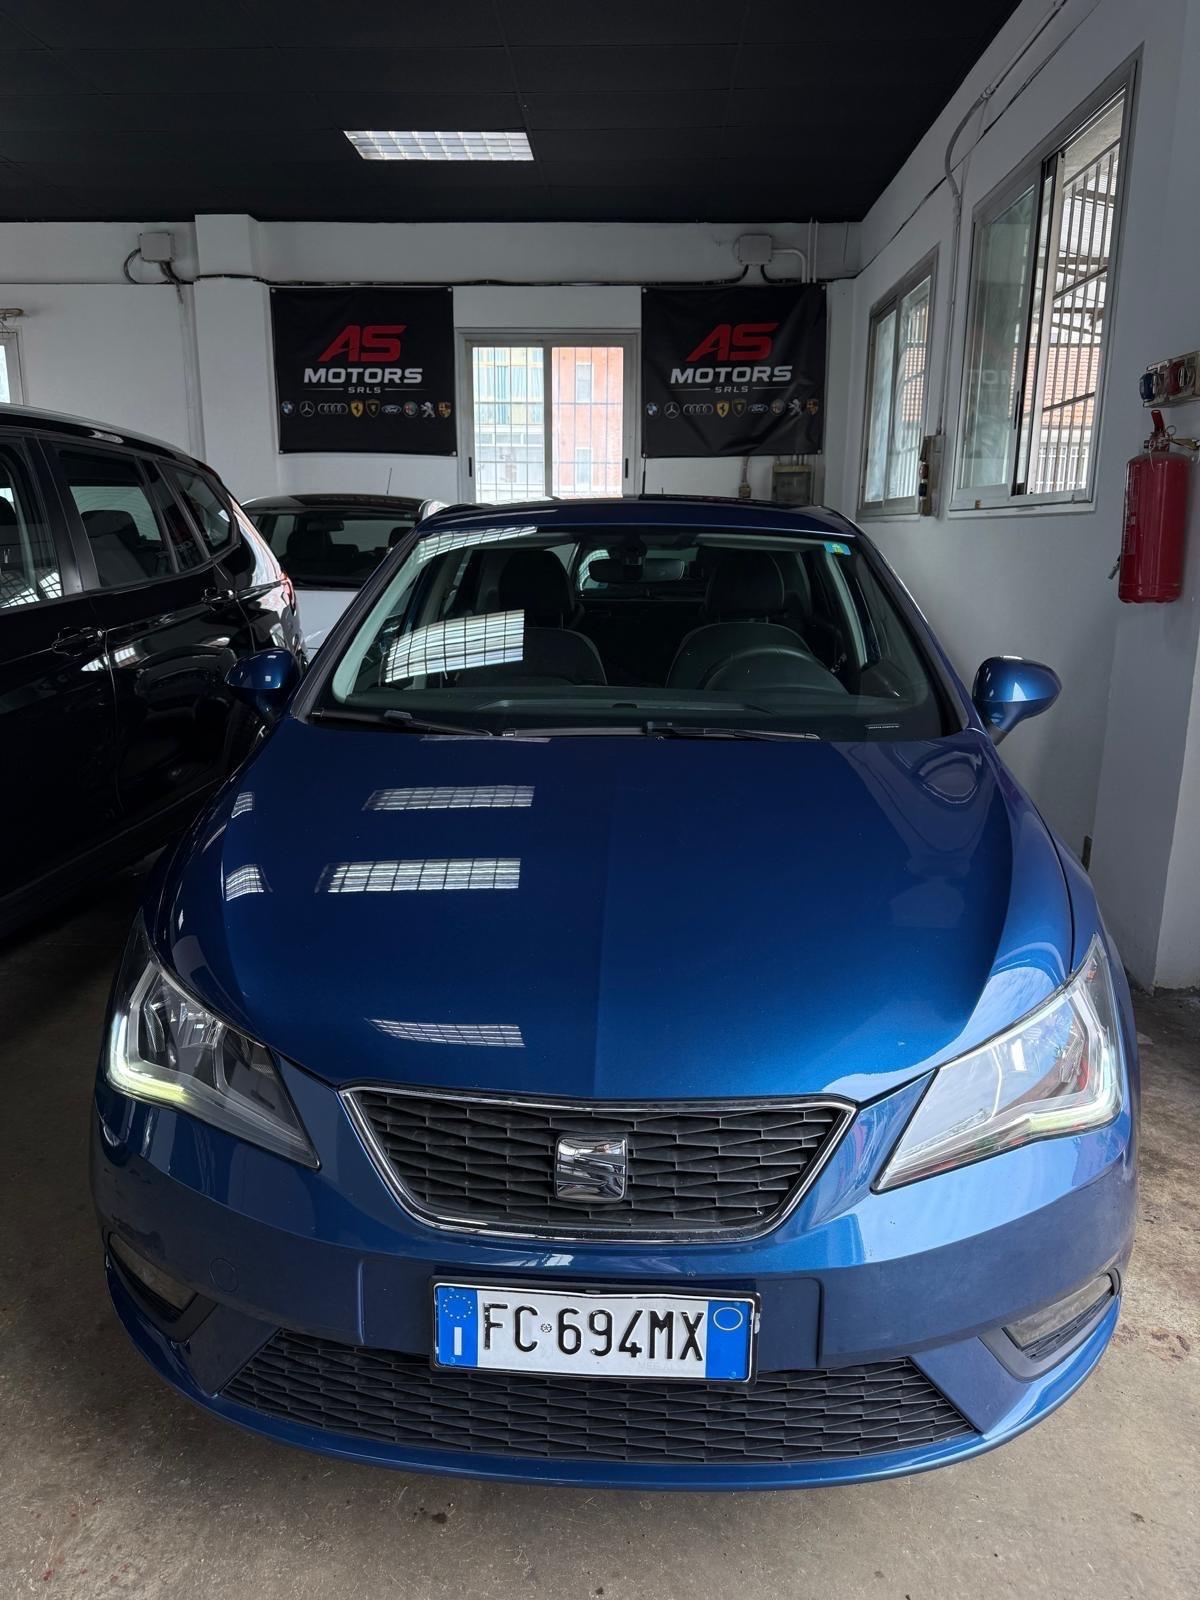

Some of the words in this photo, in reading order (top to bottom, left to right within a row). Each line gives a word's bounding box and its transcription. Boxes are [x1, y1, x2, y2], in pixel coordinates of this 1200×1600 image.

[317, 325, 407, 362] AS
[686, 323, 779, 362] AS
[303, 368, 423, 384] MOTORS
[670, 366, 793, 384] MOTORS
[347, 386, 382, 394] SRLS
[714, 385, 749, 394] SRLS
